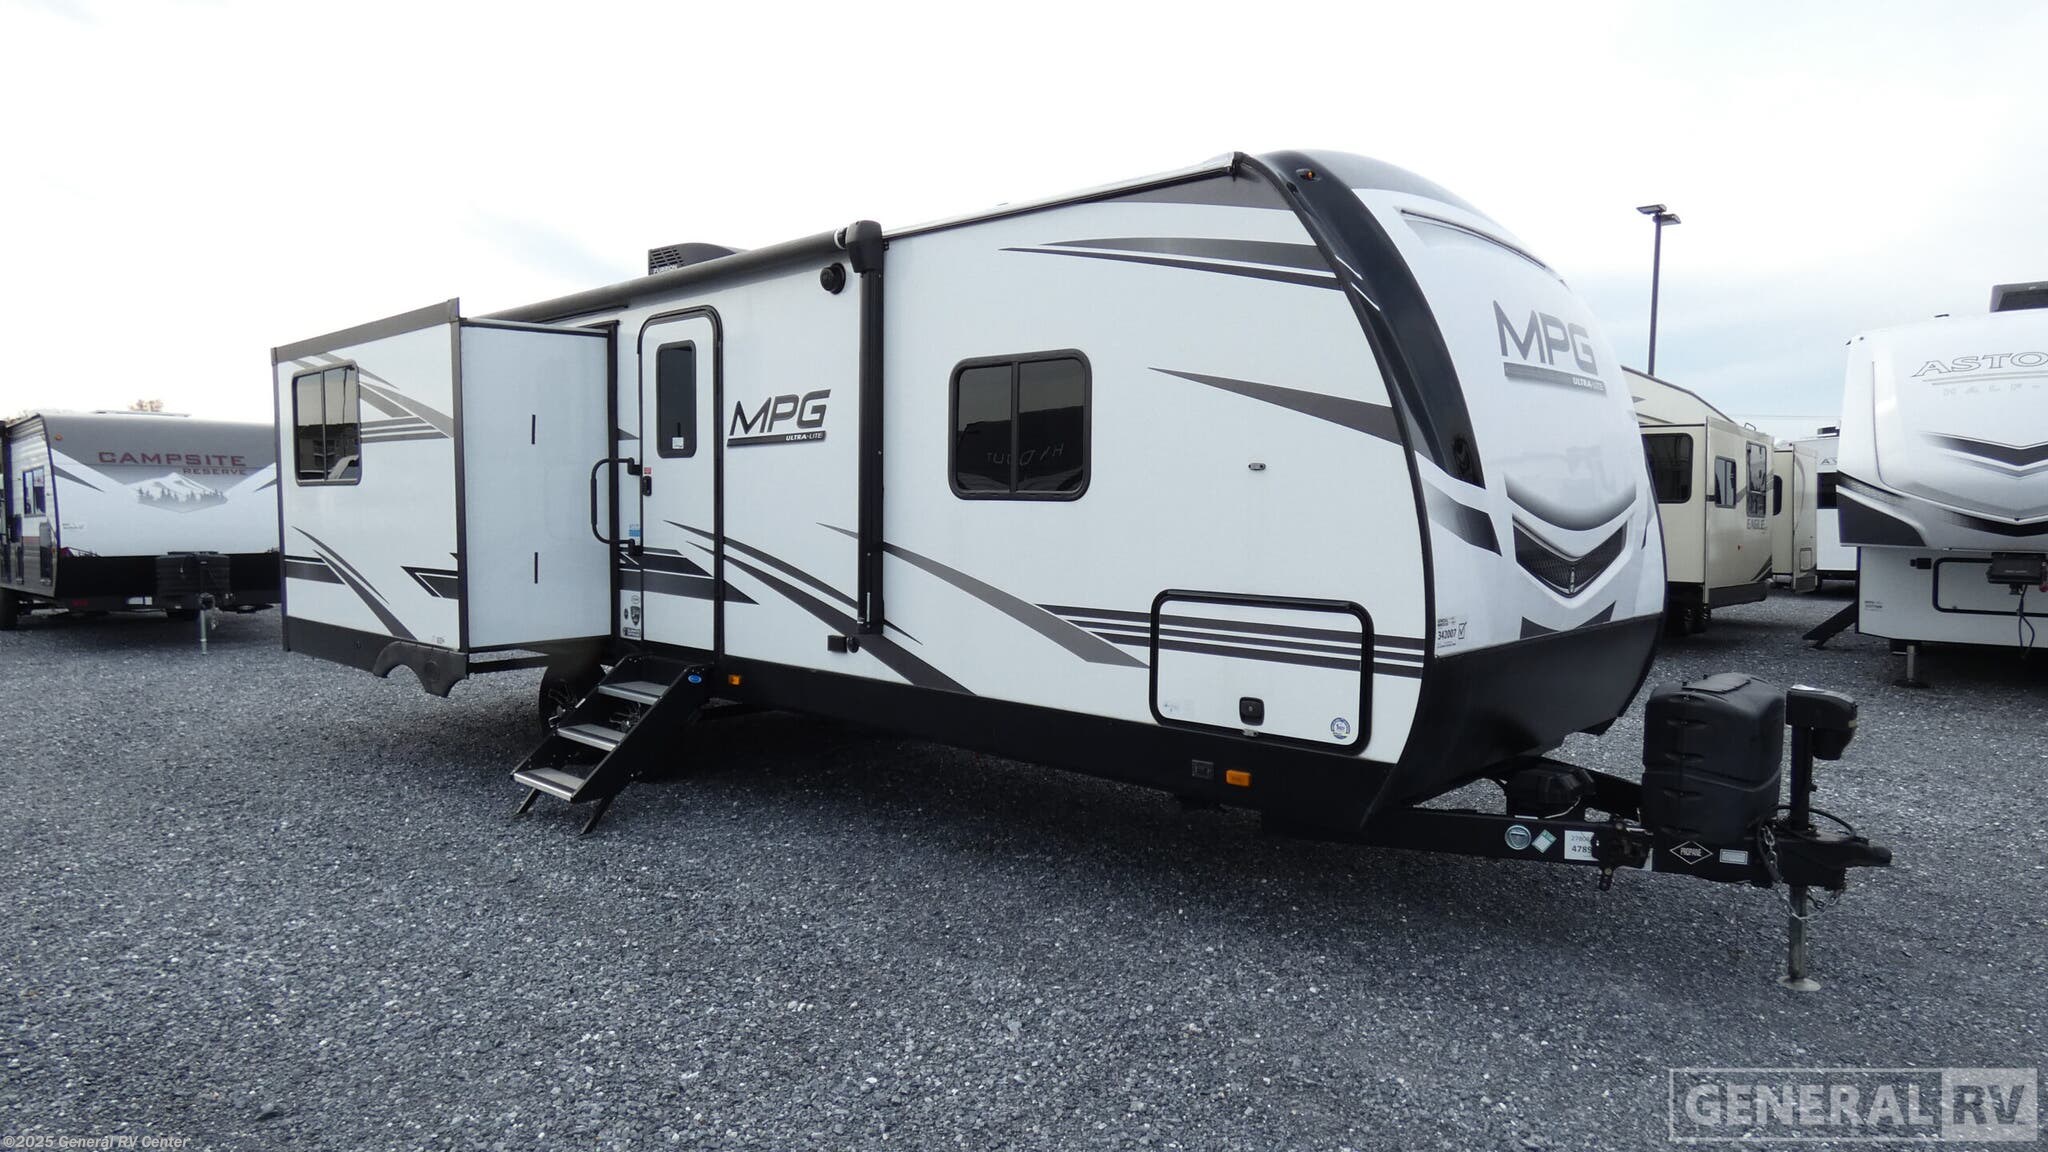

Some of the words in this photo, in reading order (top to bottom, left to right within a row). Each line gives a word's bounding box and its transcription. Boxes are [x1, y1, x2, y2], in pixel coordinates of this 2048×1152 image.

[1493, 299, 1599, 376] MPG
[1910, 351, 2048, 378] ASTO
[729, 389, 831, 436] MPG
[98, 451, 247, 467] CAMPSITE
[183, 467, 249, 476] RESERVE
